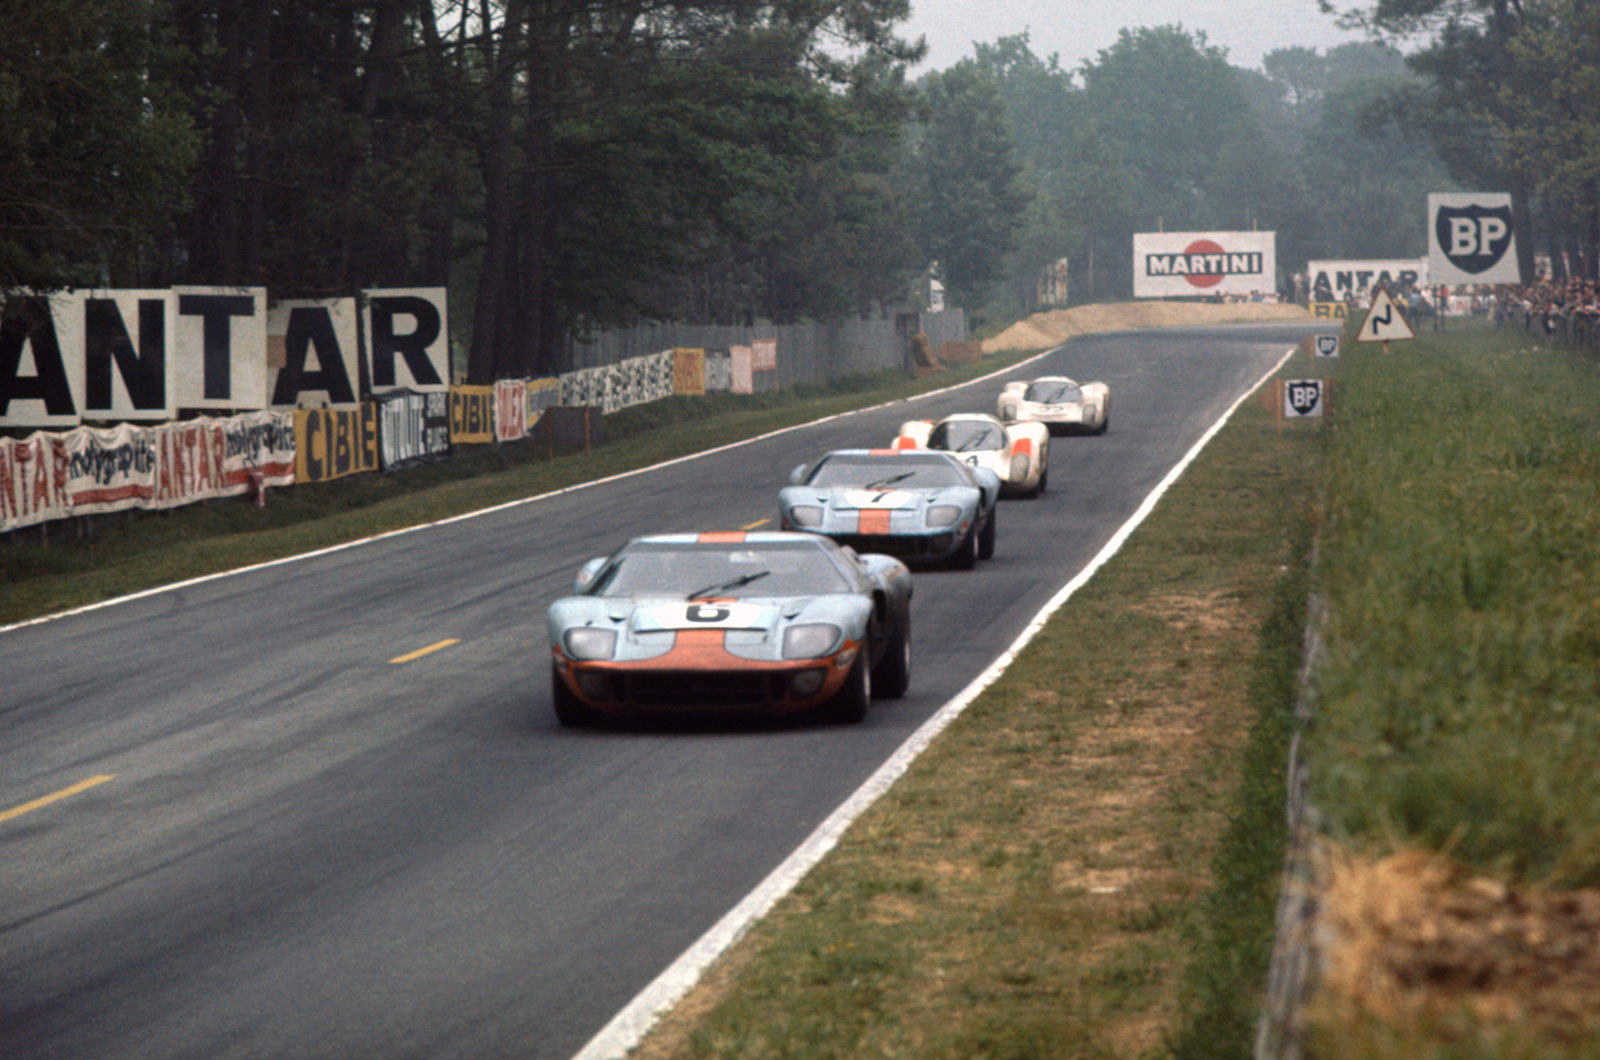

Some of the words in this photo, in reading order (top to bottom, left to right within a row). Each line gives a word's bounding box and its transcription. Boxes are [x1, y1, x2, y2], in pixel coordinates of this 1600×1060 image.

[1448, 216, 1507, 256] BP
[1149, 253, 1260, 275] MARTINI
[0, 294, 444, 417] ANTAR
[1319, 339, 1336, 352] BP
[1292, 386, 1318, 408] BP
[685, 603, 731, 623] 6
